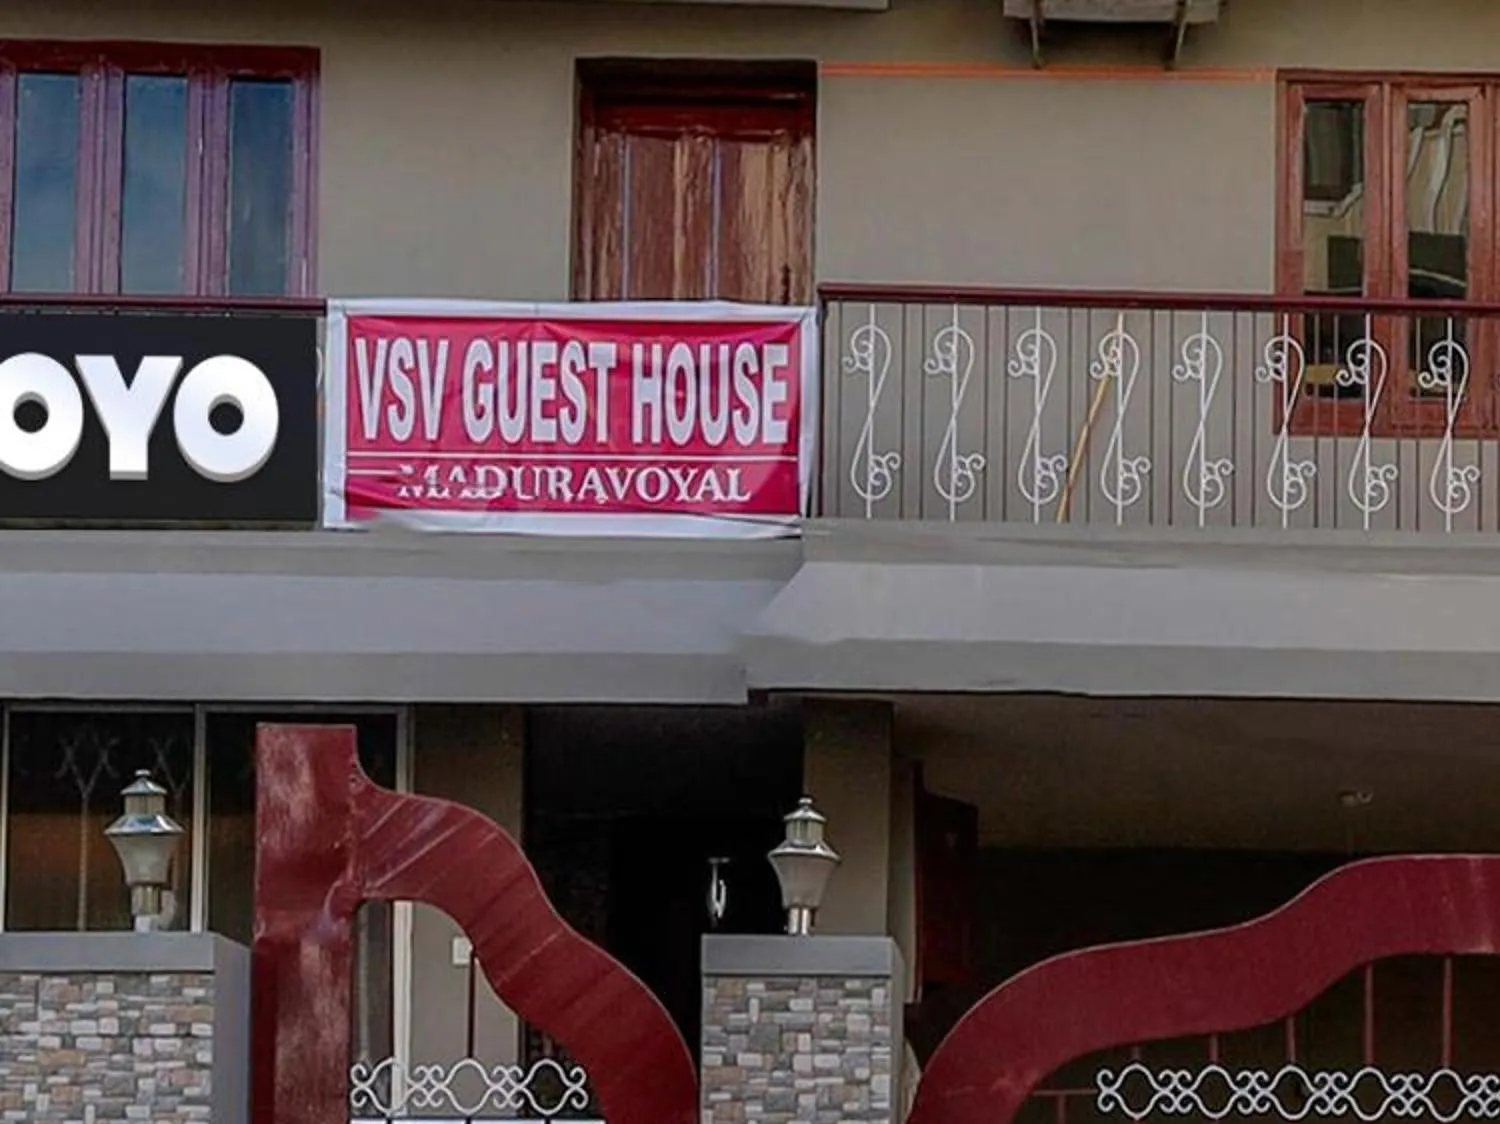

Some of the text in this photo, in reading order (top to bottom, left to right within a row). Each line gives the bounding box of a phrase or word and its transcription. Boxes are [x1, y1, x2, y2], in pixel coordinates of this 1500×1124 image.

[0, 352, 279, 483] OYO
[354, 336, 790, 446] VSV GUEST HOUSE
